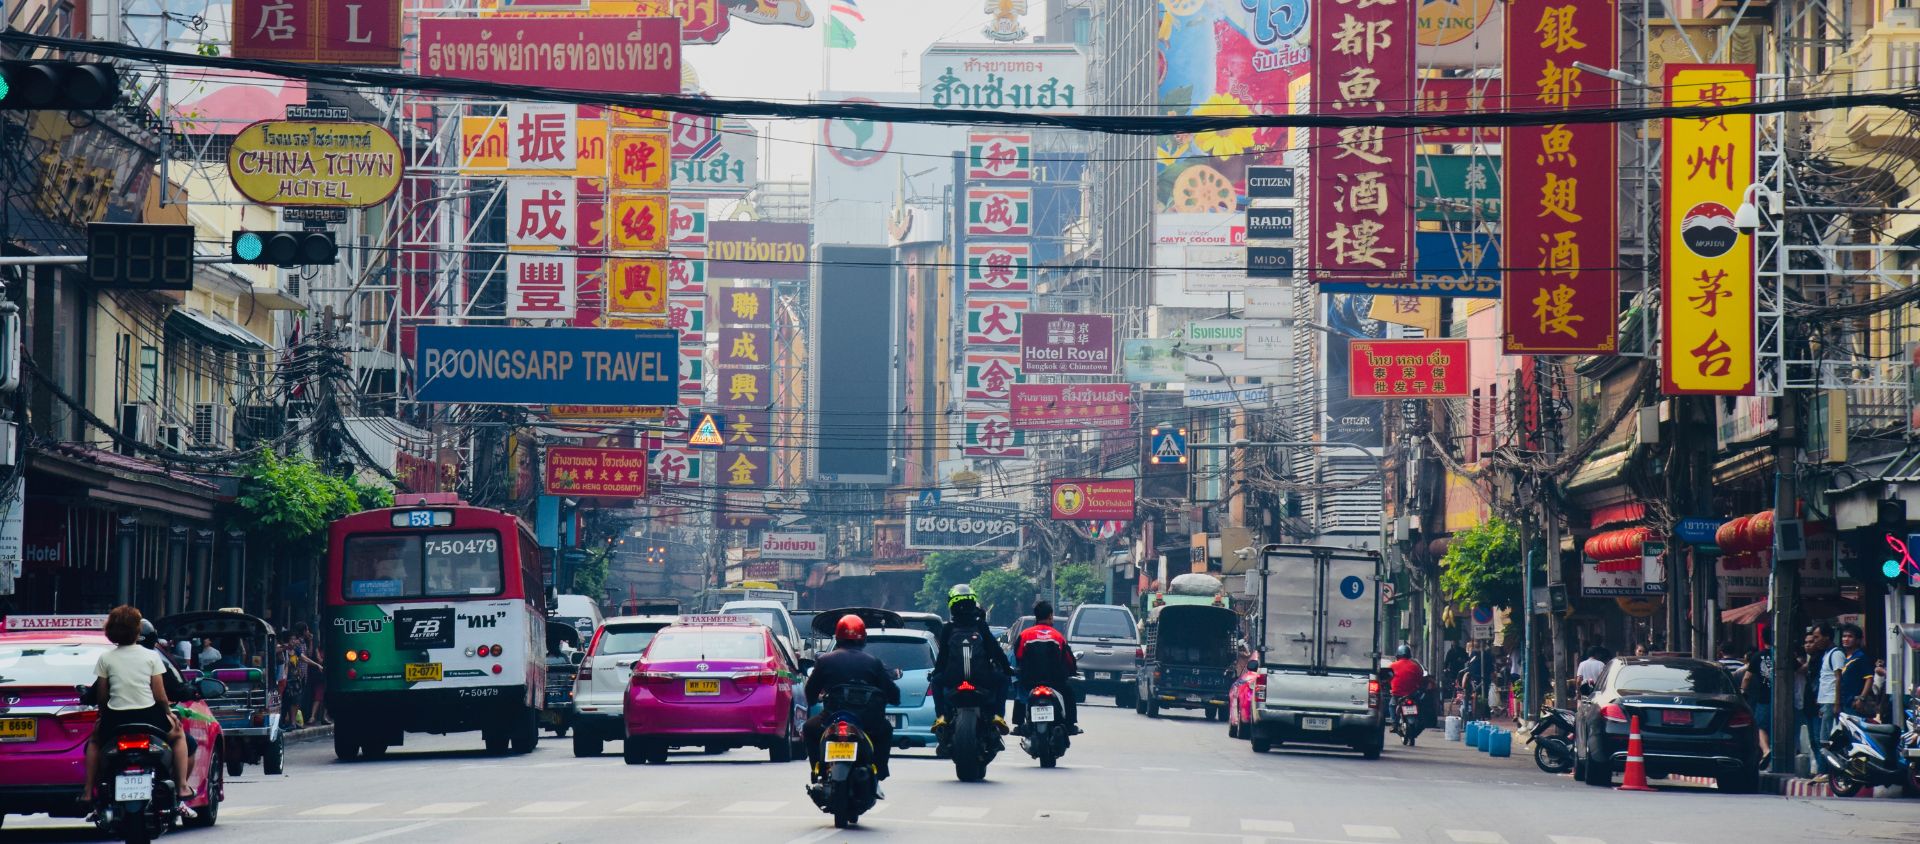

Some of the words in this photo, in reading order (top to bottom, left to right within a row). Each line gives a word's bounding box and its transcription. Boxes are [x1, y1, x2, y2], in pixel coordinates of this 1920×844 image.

[346, 4, 372, 43] L
[1437, 17, 1475, 29] SING
[429, 20, 672, 76] ร่งทรัพย์การท่องเที่ยว
[1326, 0, 1394, 268] 都魚翅酒樓
[238, 151, 316, 176] CHINA
[325, 152, 394, 177] TOWN
[1532, 5, 1587, 338] 銀都魚翅酒樓
[1250, 177, 1291, 187] CITIZEN
[278, 179, 353, 199] HOTEL
[1250, 217, 1292, 226] RADO
[1254, 256, 1286, 264] MIDO
[978, 142, 1016, 452] 和成興大金行
[1688, 268, 1732, 376] 茅台
[1025, 346, 1063, 360] Hotel
[1067, 347, 1108, 362] Royal
[425, 348, 573, 381] ROONGSARP
[582, 351, 669, 381] TRAVEL
[1026, 362, 1057, 371] Bangkok
[1069, 362, 1108, 370] Chinatown
[1189, 389, 1240, 401] BROADWAY
[1244, 389, 1271, 401] HOTE
[1341, 416, 1370, 425] CITIZEN
[603, 484, 642, 492] GOLDSMITH
[1087, 496, 1104, 507] Yoo
[411, 512, 431, 526] 53
[26, 542, 61, 561] Hotel
[425, 539, 497, 555] 7-50479
[1352, 582, 1359, 593] 9
[22, 618, 93, 627] TAXI-METER
[691, 615, 737, 623] TAXI-METER
[1338, 619, 1352, 627] A9
[412, 619, 440, 634] FB
[459, 688, 498, 697] 7-50479
[121, 792, 145, 800] 6472
